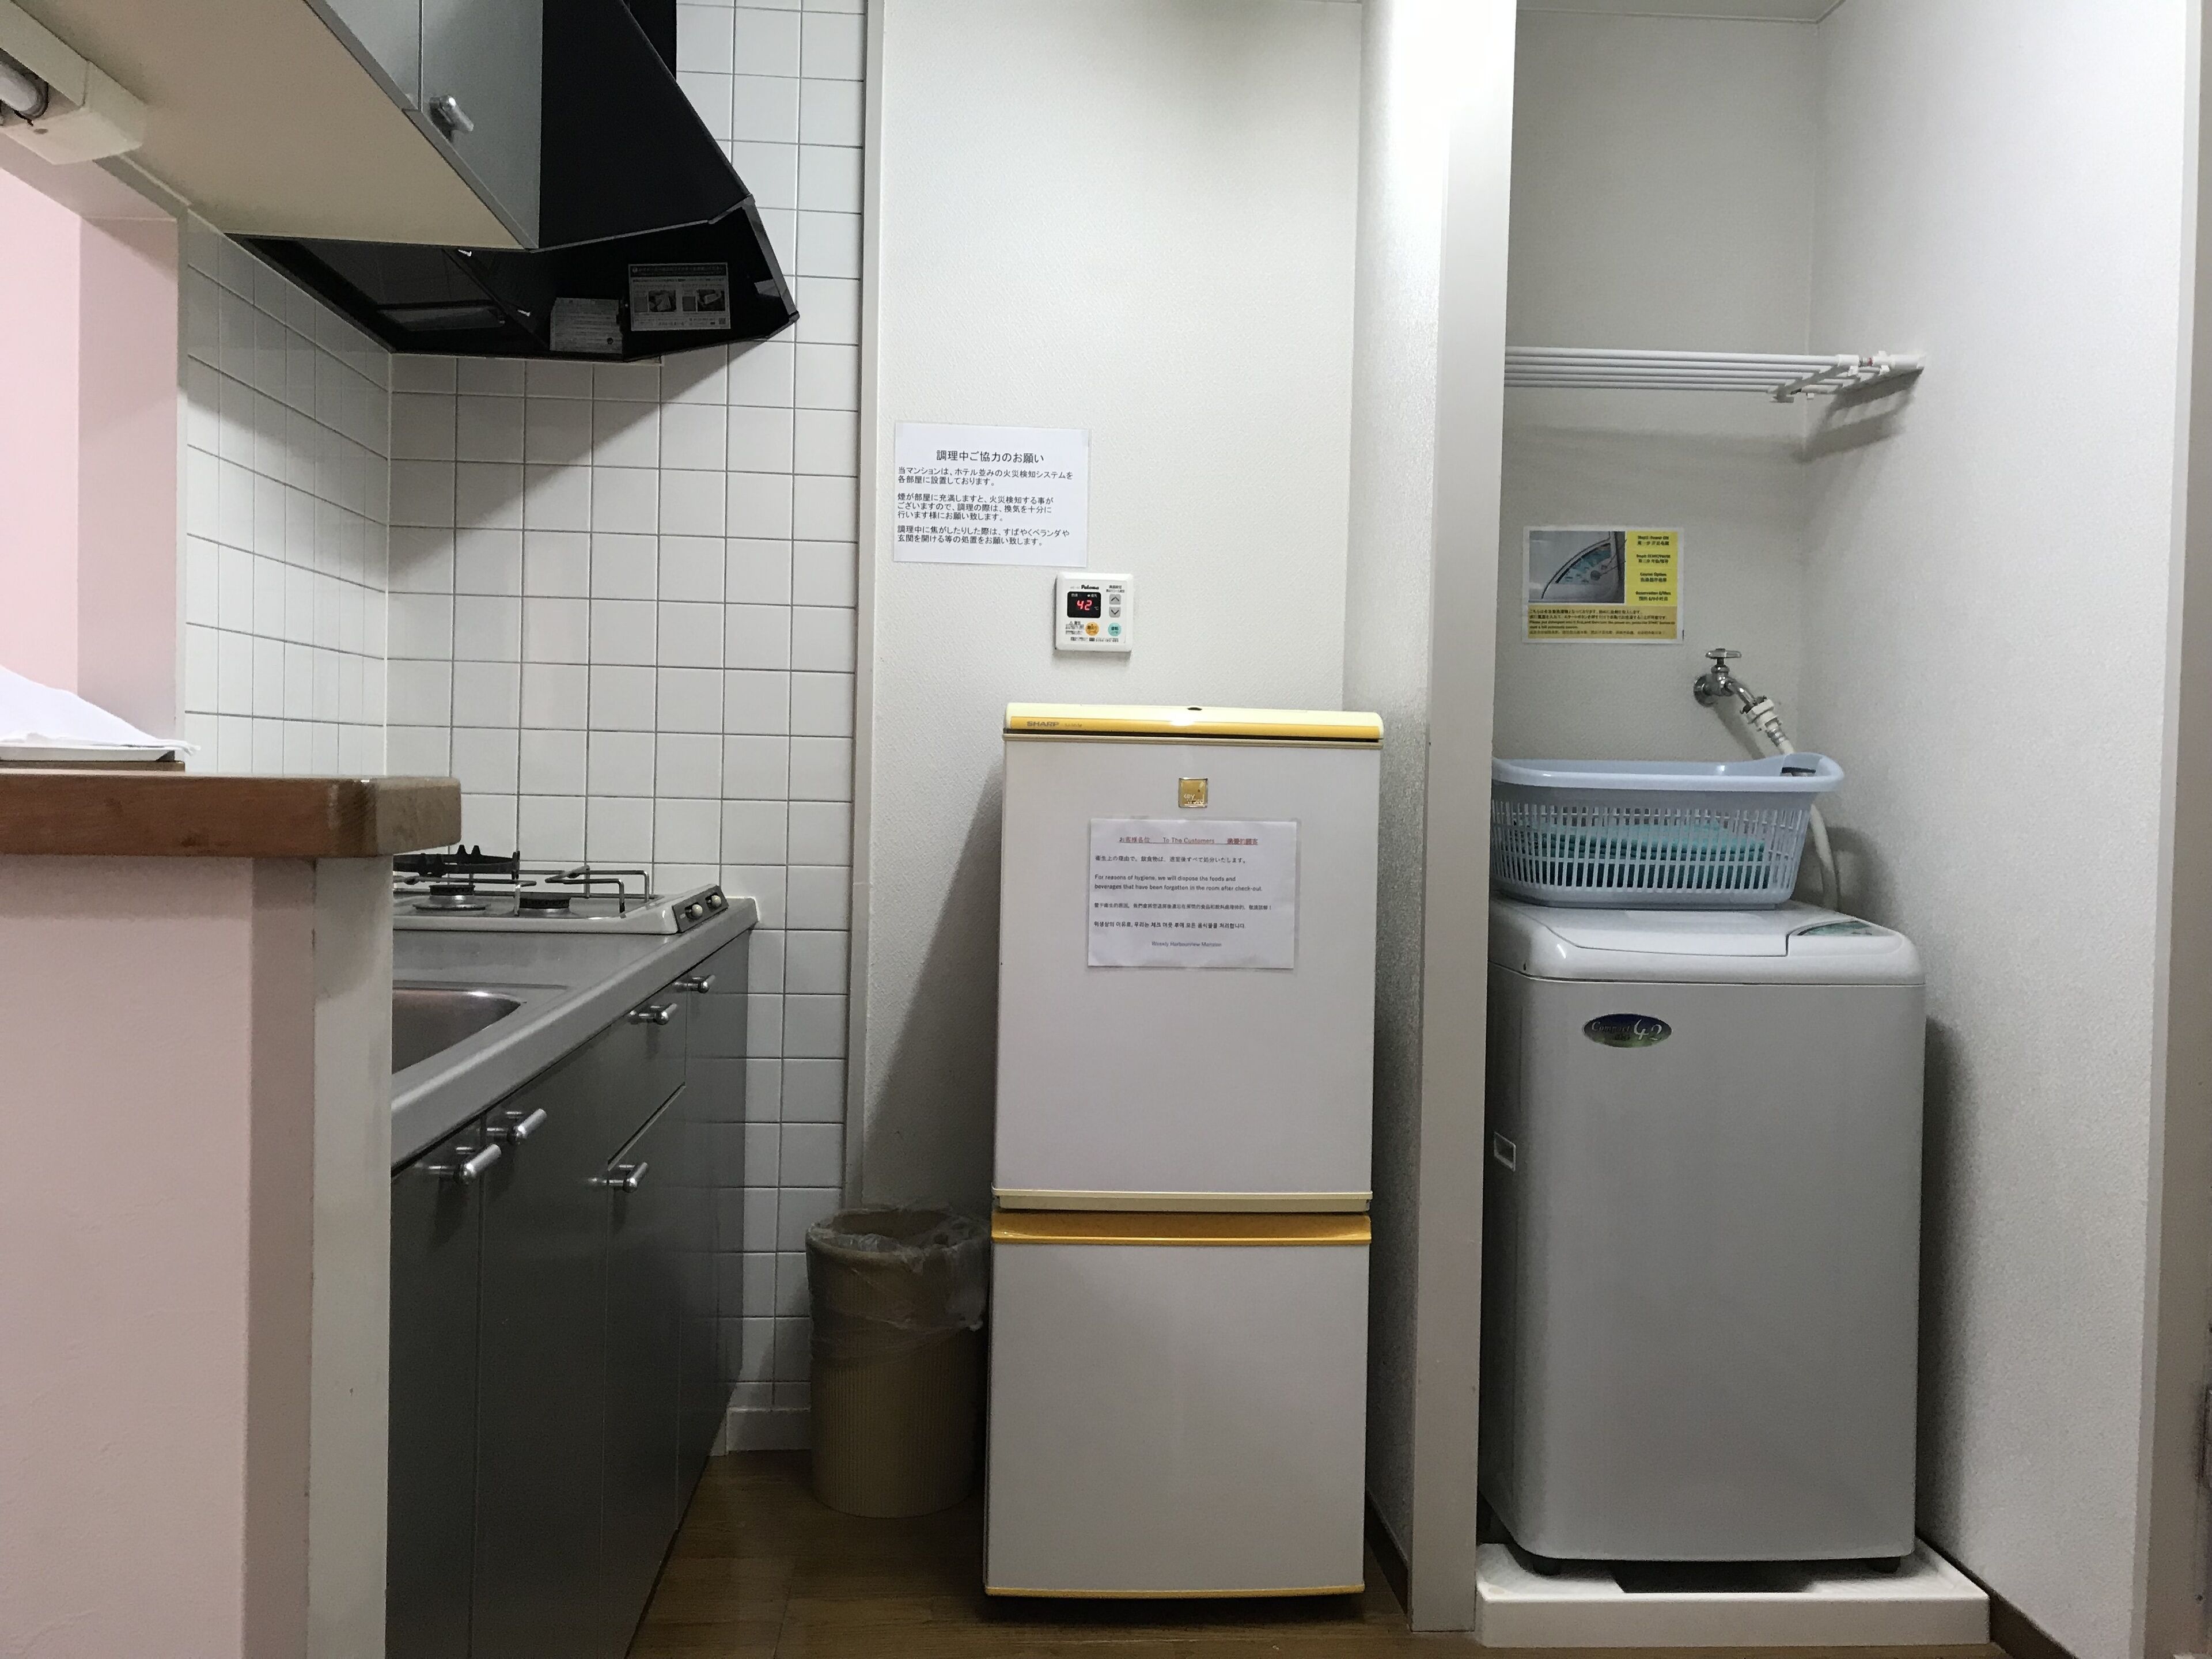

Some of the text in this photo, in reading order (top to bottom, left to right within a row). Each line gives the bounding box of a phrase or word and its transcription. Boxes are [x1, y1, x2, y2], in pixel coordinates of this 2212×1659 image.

[936, 449, 1044, 464] 調理中ご協力のお願い
[898, 467, 1073, 480] 当マンションは、ホテル並みの火災検知システムを
[898, 475, 994, 486] 各部屋に設置しております。
[897, 493, 1054, 505] 煙が部屋に充満しますと、火災検知する事が
[897, 502, 1052, 514] ございますので、調理の際は、換気を十分に
[897, 511, 1003, 521] 行います様にお願い致します。
[897, 534, 1042, 546] 玄関を開ける等の処置をお願い致します。
[1077, 600, 1092, 611] 42
